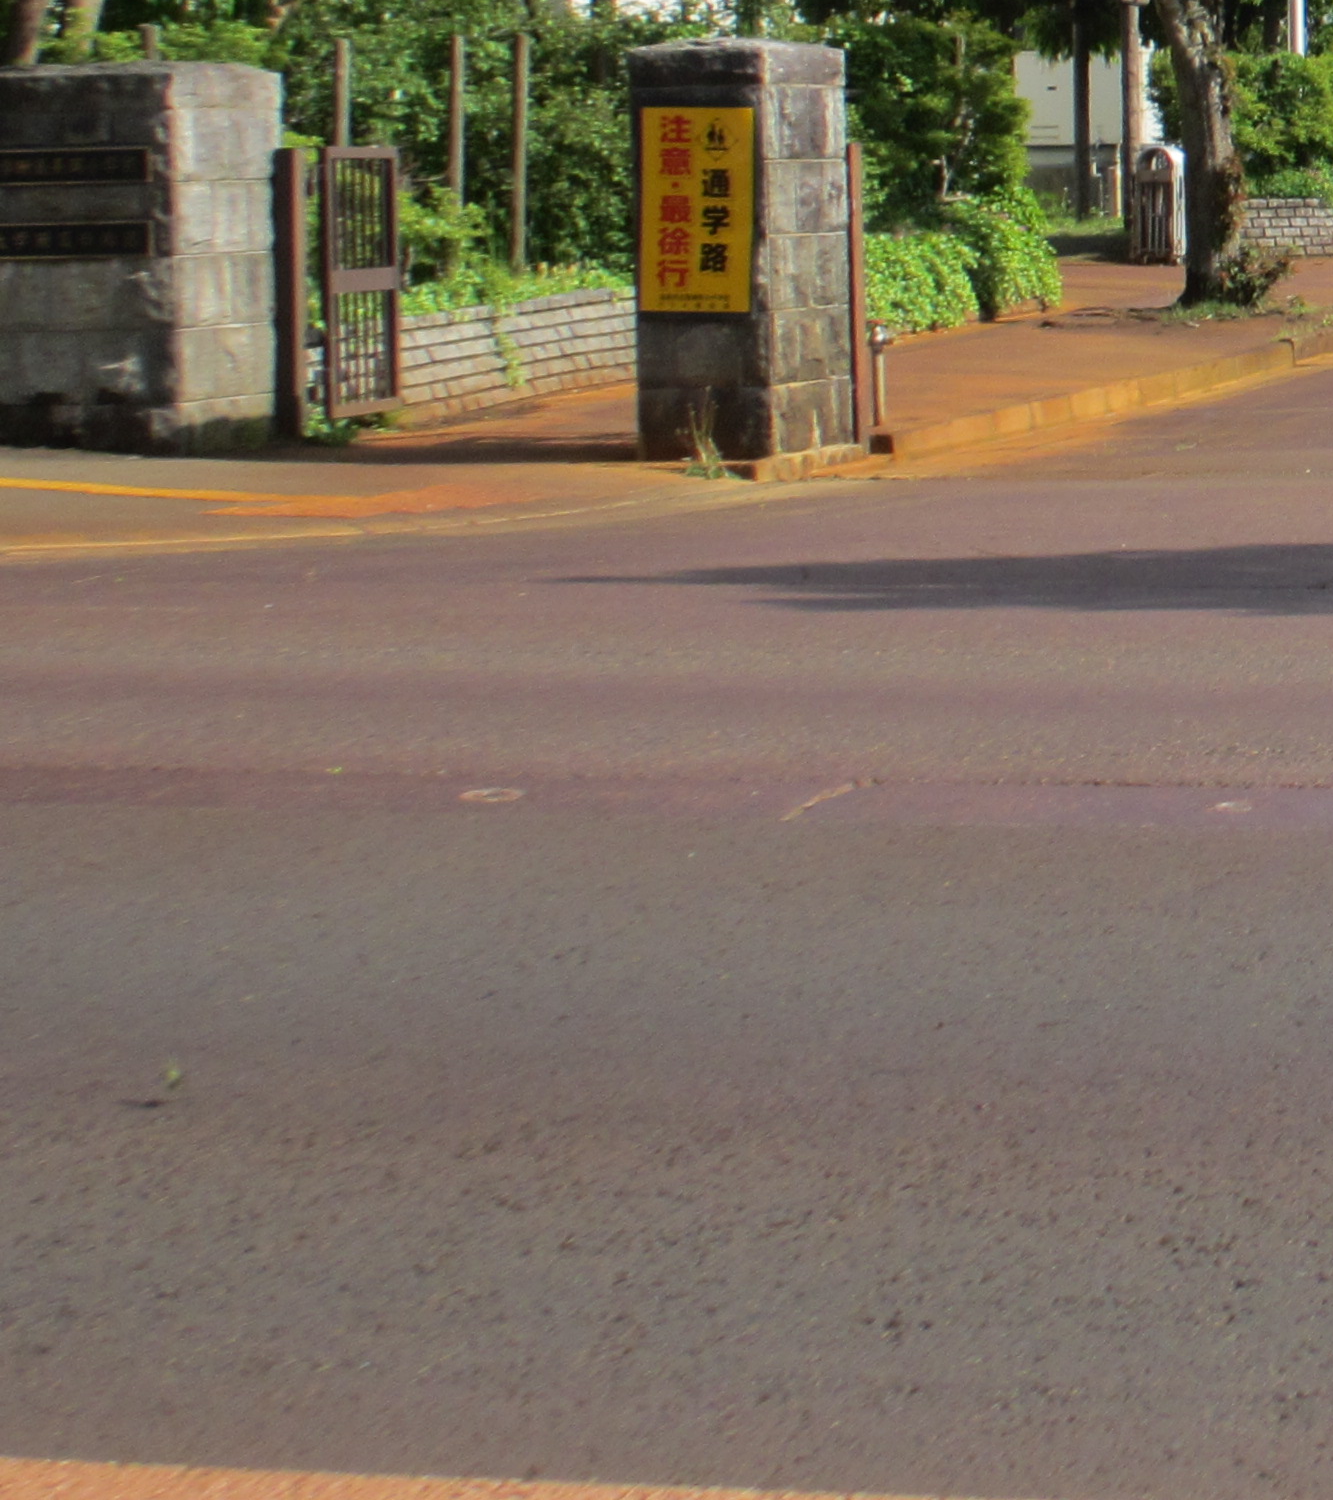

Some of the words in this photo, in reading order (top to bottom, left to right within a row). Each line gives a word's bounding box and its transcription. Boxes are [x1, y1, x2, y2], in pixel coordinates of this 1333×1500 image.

[656, 114, 692, 288] 注意・最徐行
[701, 168, 730, 273] 通学路
